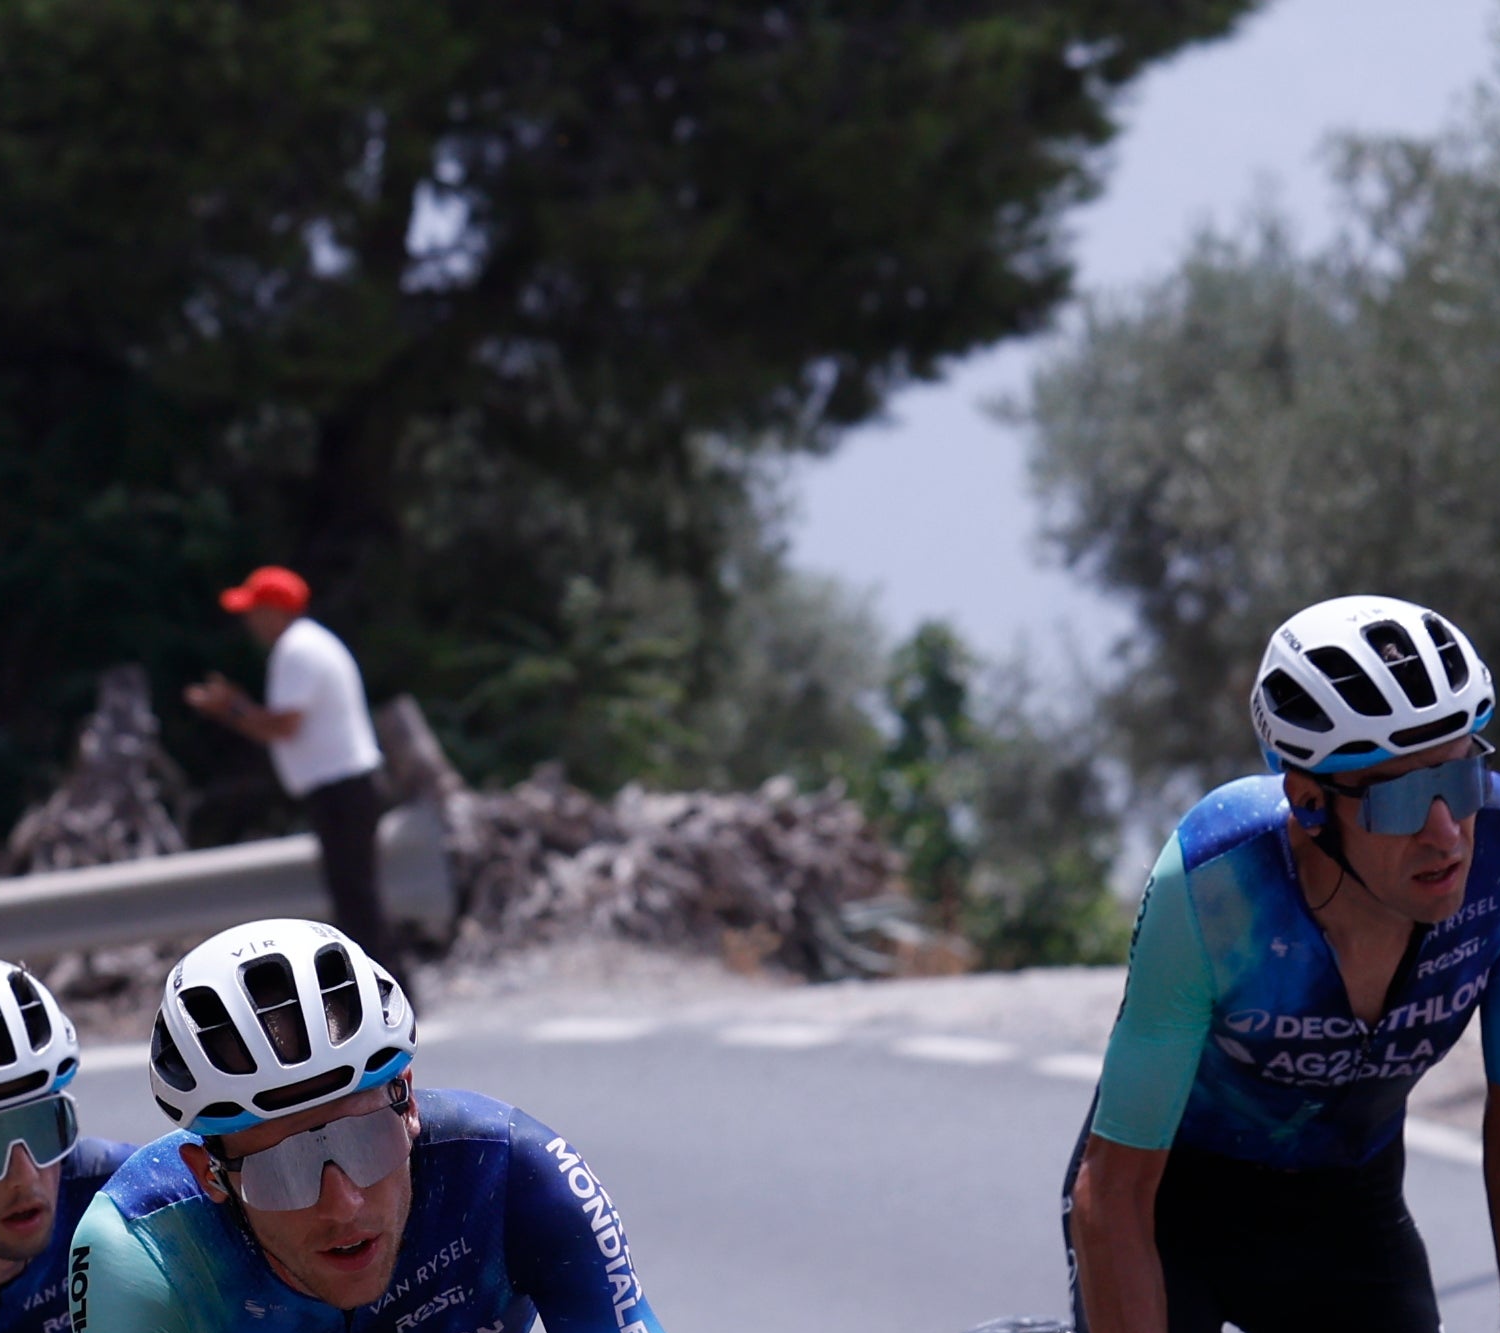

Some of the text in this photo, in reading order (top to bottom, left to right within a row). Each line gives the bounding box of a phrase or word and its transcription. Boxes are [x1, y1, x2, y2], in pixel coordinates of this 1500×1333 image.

[1444, 896, 1499, 932] RYSEL
[1384, 1038, 1434, 1062] LA
[369, 1236, 472, 1315] VAN RYSEL
